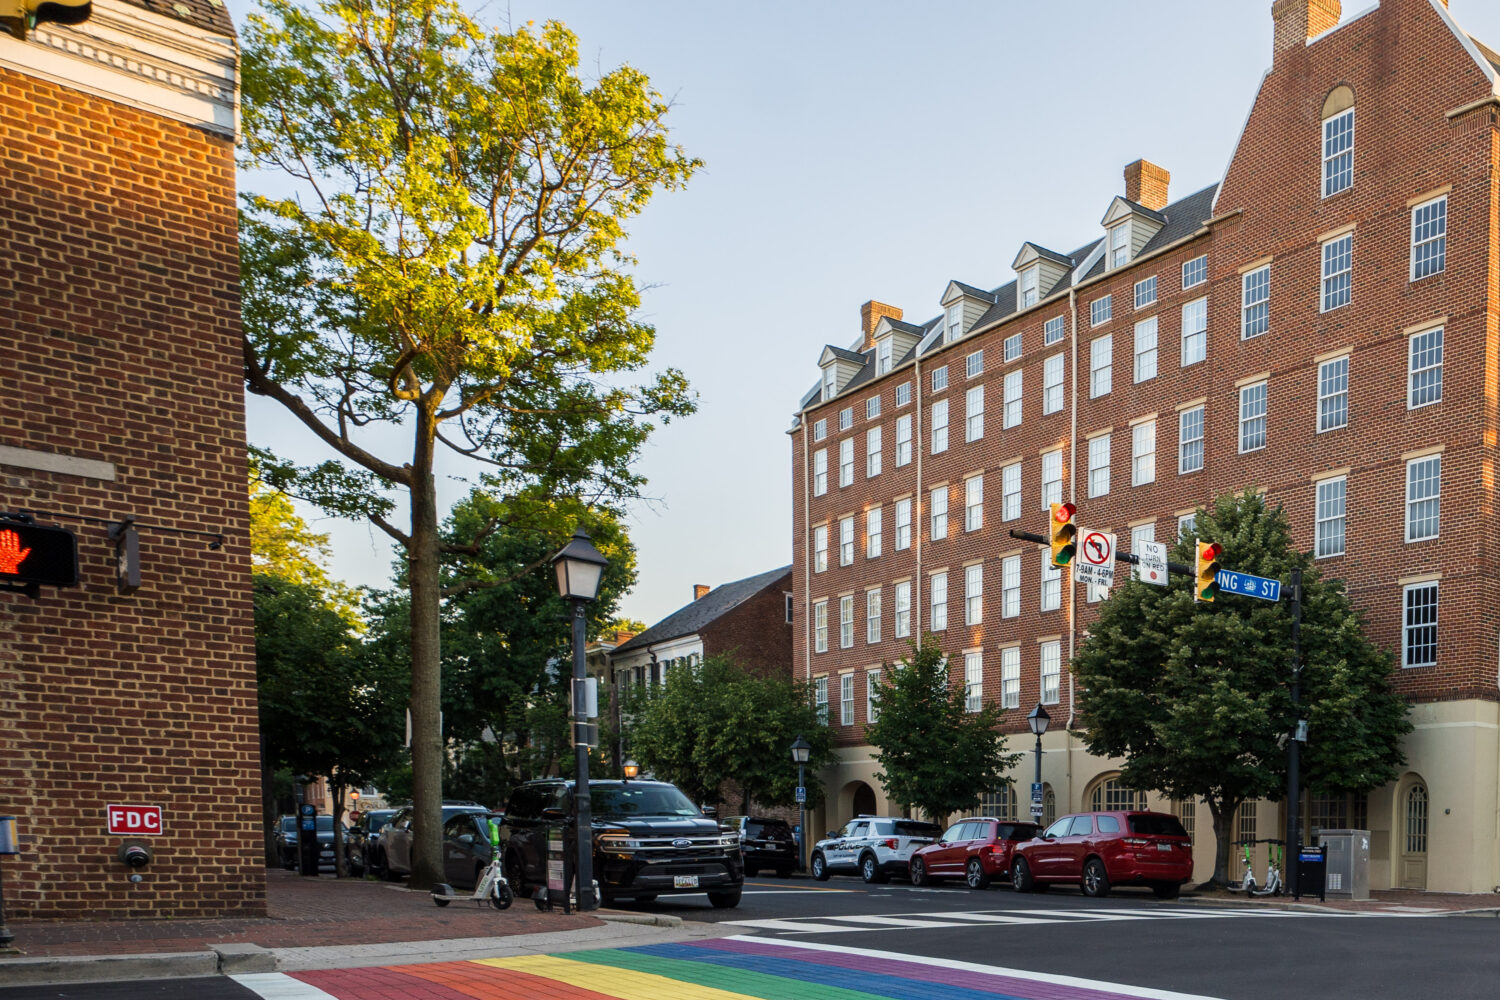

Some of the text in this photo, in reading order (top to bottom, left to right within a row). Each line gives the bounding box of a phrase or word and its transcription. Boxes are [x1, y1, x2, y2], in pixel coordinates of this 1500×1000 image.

[1146, 544, 1158, 554] NO
[1145, 554, 1161, 563] TURN
[1076, 564, 1093, 575] 7-9AM
[1097, 568, 1114, 579] 4-6PM
[1152, 563, 1164, 572] RED
[1218, 571, 1276, 597] ING ST
[112, 811, 158, 828] FDC
